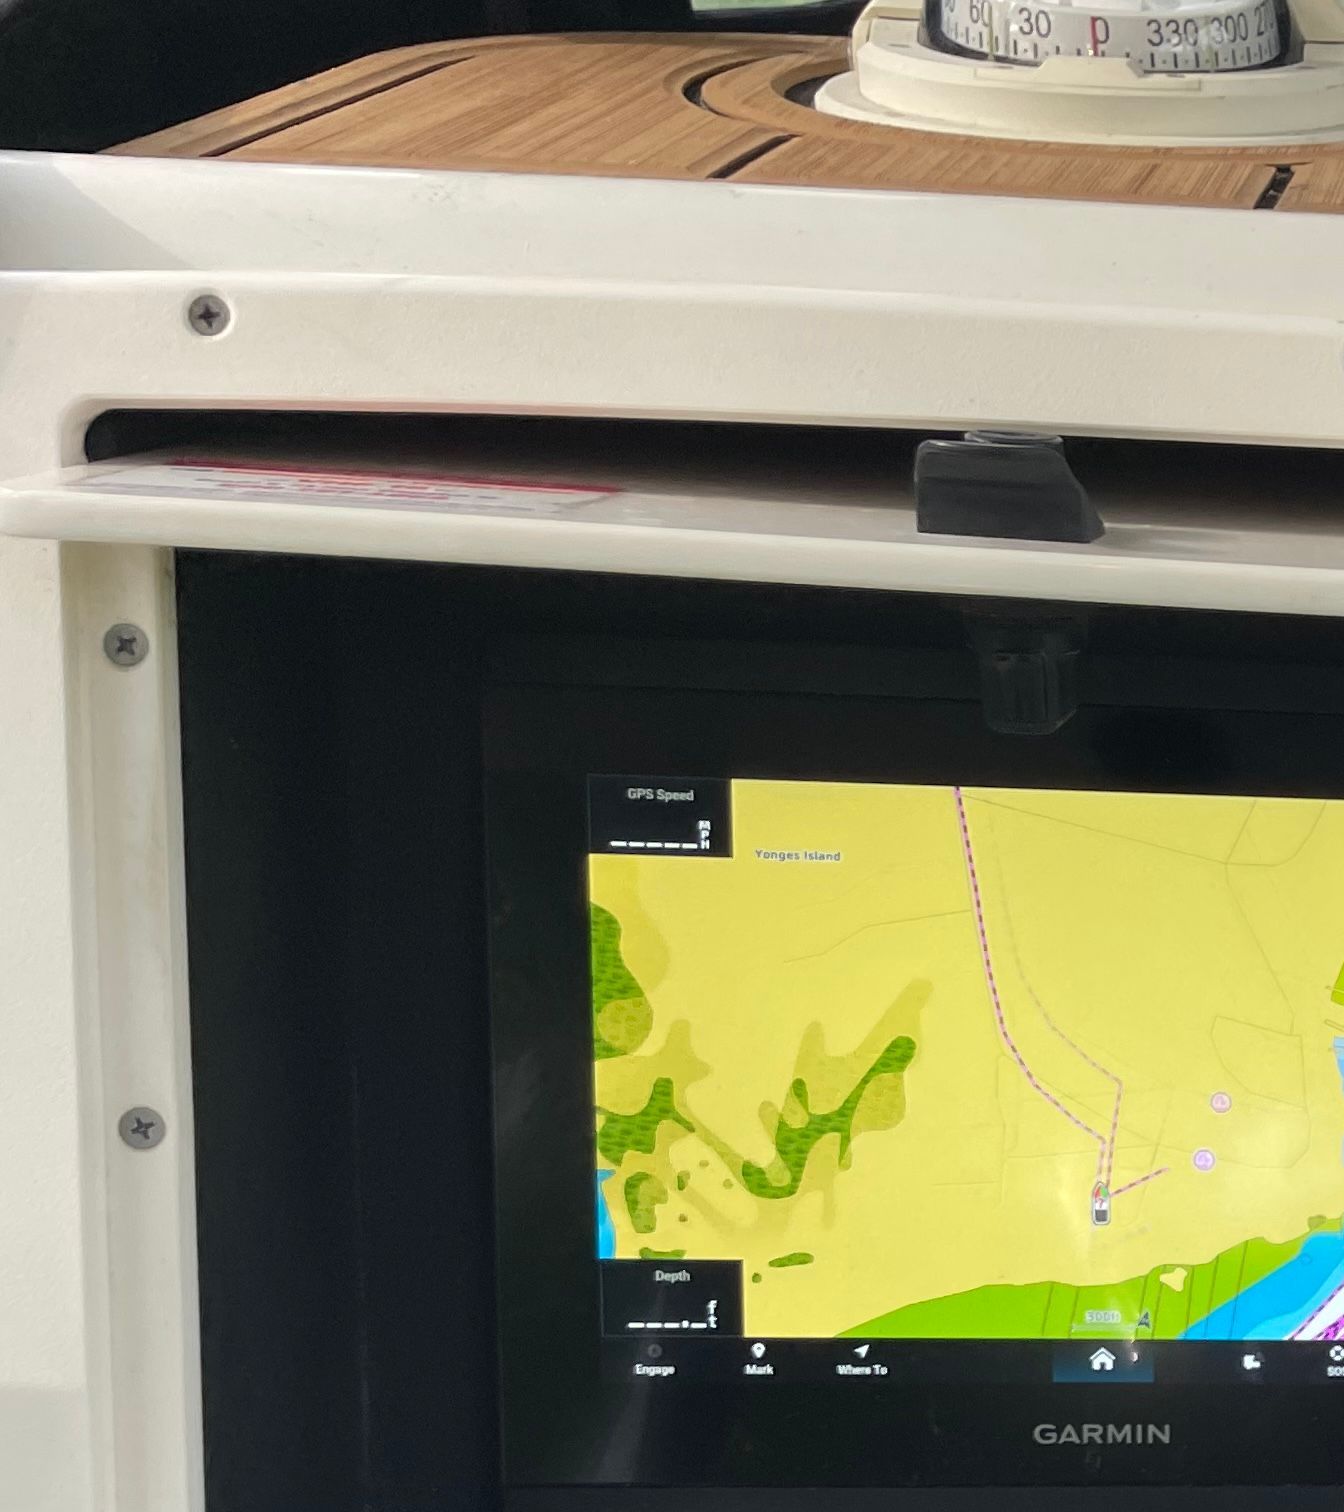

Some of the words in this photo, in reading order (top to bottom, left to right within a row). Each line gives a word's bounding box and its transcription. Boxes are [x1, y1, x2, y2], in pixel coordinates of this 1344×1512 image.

[1019, 7, 1051, 38] 30
[1147, 18, 1199, 46] 330
[627, 787, 654, 801] GPS
[656, 788, 695, 803] Speed
[755, 849, 800, 861] Yonges
[804, 851, 841, 861] Island
[655, 1270, 691, 1285] Depth
[634, 1363, 676, 1378] Engage
[743, 1364, 775, 1376] Mark
[836, 1364, 870, 1377] Where
[872, 1364, 889, 1377] To
[1033, 1424, 1171, 1445] GARMIN
